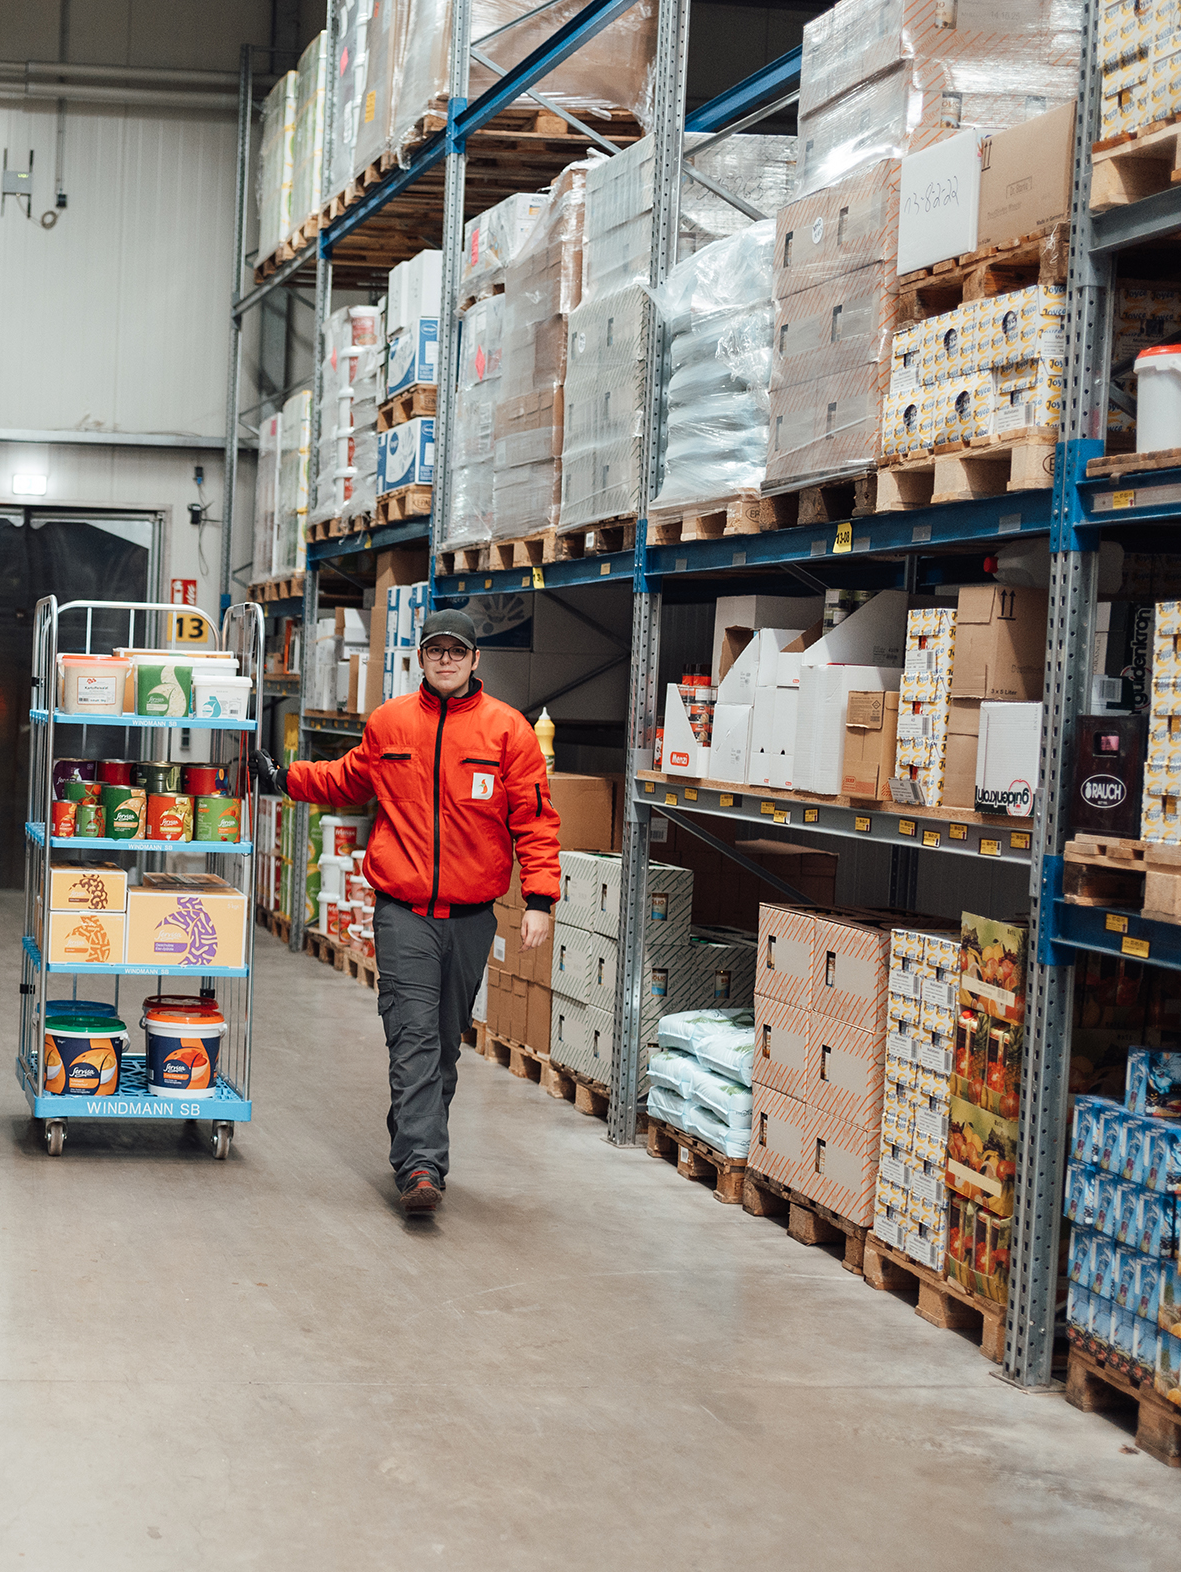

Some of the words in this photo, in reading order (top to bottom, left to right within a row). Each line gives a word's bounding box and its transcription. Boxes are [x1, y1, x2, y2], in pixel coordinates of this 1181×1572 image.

[176, 617, 204, 638] 13
[671, 753, 689, 765] Menzi
[1092, 783, 1122, 800] RAUCH
[87, 1101, 173, 1115] WINDMANN
[180, 1103, 200, 1116] SB
